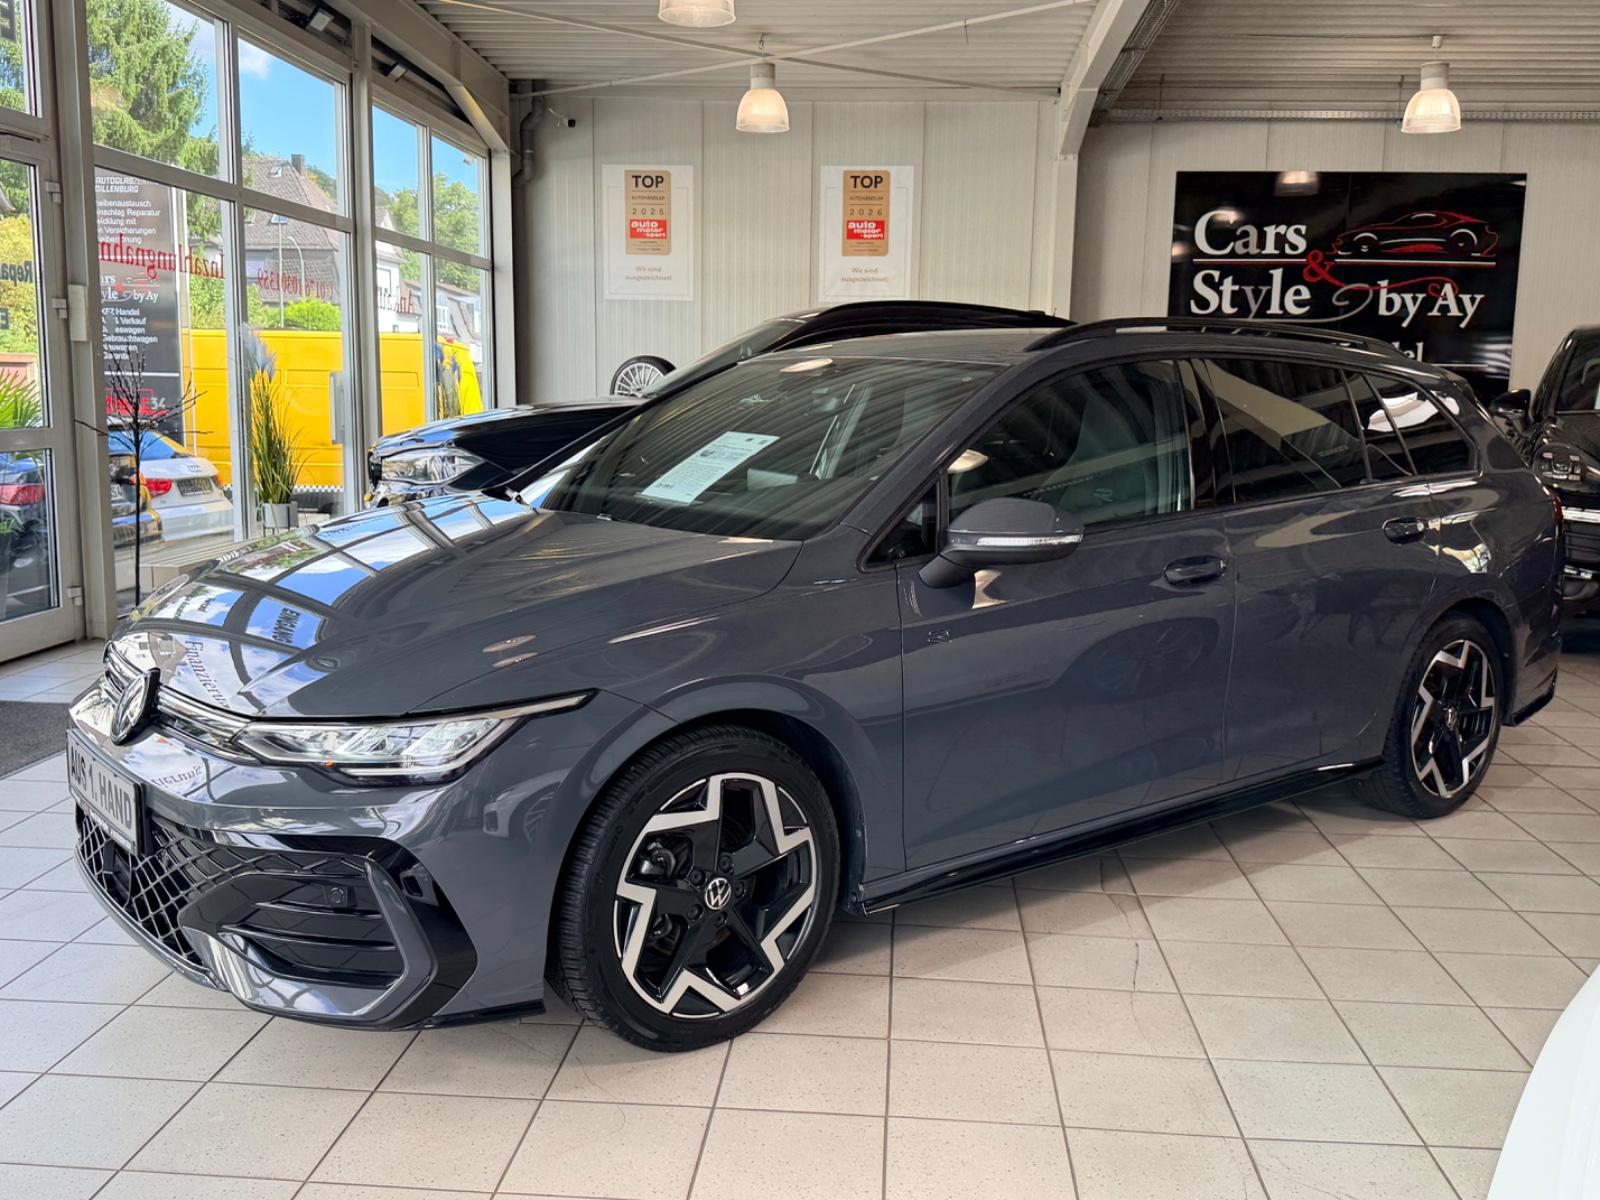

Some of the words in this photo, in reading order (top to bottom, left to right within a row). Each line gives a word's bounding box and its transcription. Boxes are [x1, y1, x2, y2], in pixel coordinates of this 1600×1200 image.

[631, 175, 664, 188] TOP
[850, 175, 884, 189] TOP
[127, 208, 161, 217] Reparatur
[849, 208, 883, 216] 2026
[848, 221, 876, 229] auto
[104, 226, 157, 236] Versicherungen
[1193, 209, 1307, 255] Cars
[1302, 249, 1336, 284] &
[1190, 267, 1311, 319] Style
[1377, 279, 1426, 328] by
[1427, 283, 1485, 329] Ay
[115, 307, 140, 316] Handel
[120, 316, 147, 325] Verkauf
[71, 745, 87, 792] AUS
[98, 771, 132, 830] HAND
